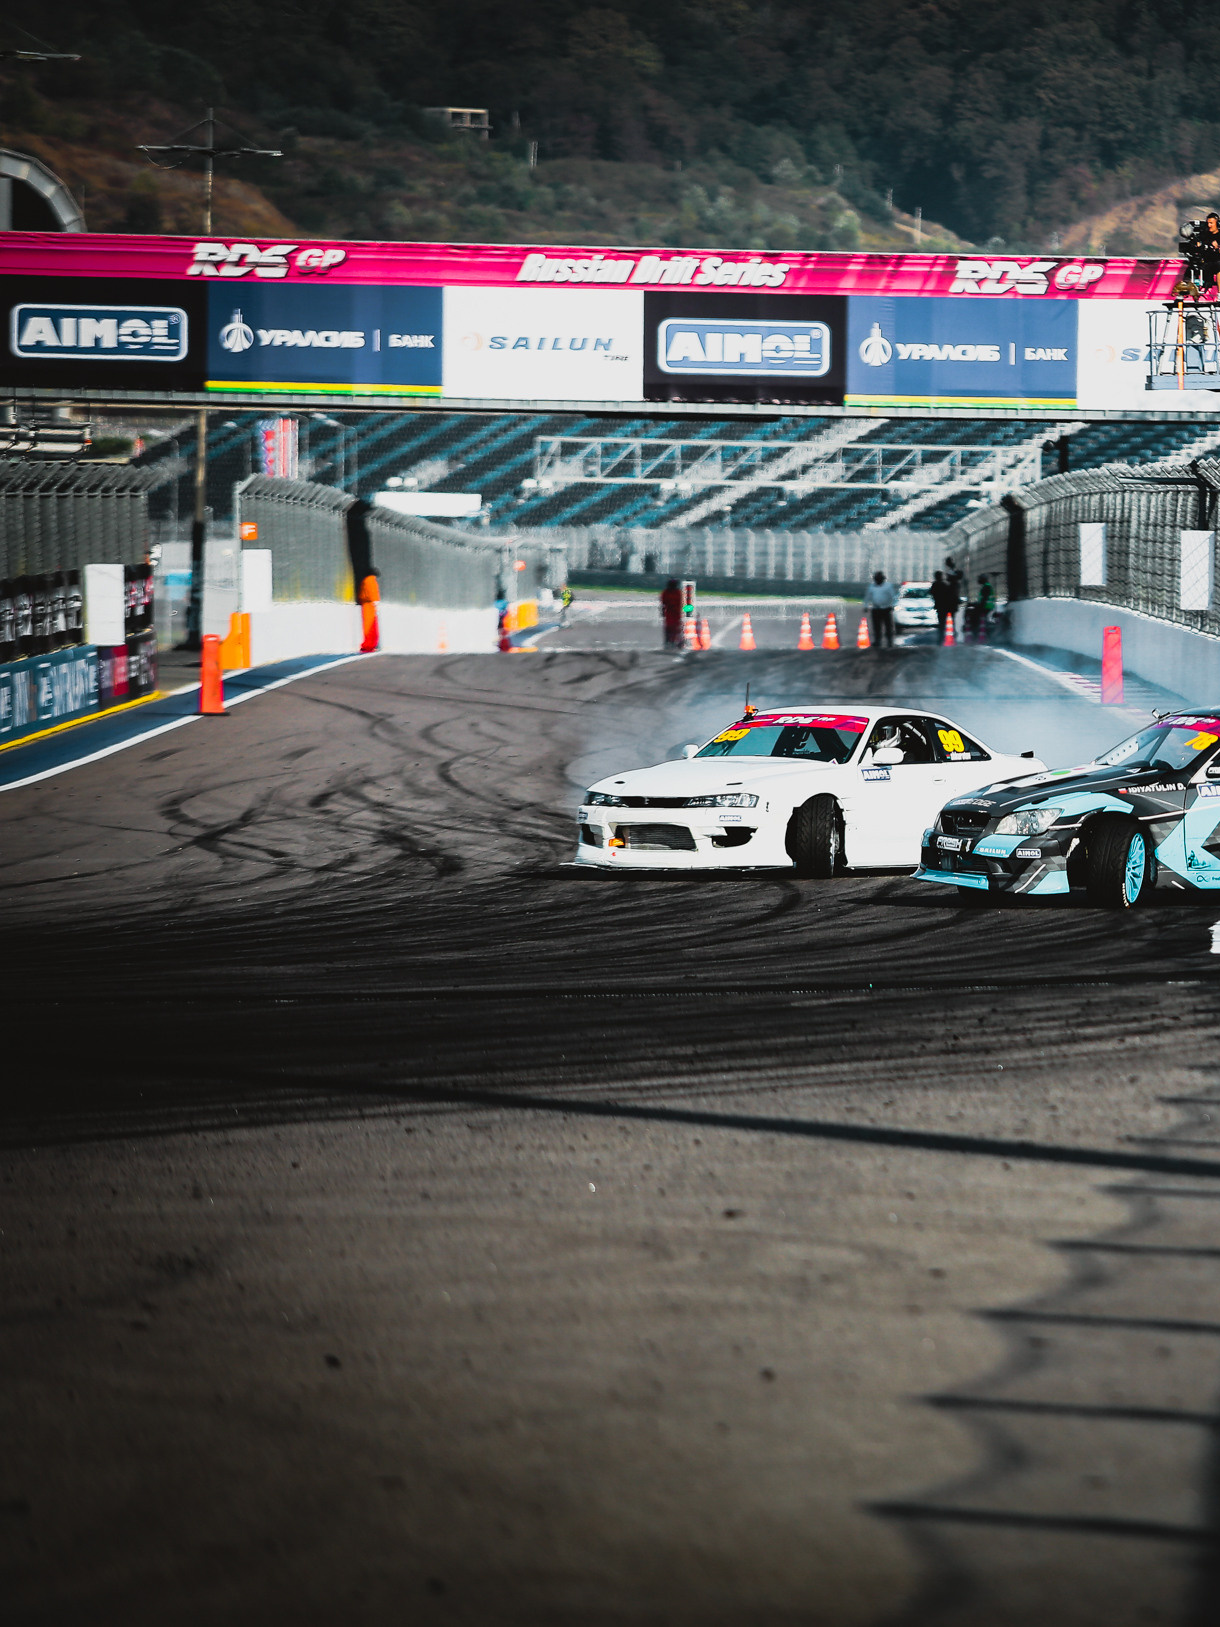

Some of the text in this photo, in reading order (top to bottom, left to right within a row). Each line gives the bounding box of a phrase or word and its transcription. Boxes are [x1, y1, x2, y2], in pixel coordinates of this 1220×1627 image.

[186, 242, 347, 278] RDS GP
[515, 253, 790, 287] Russian Drift Series
[949, 260, 1104, 295] RDS GP
[19, 316, 180, 350] AIMOL
[388, 334, 435, 348] БАНК
[489, 336, 613, 351] SAILUN
[666, 330, 822, 365] AIMOL
[1024, 347, 1069, 361] БАНК
[713, 728, 751, 743] 99
[937, 729, 965, 752] 99
